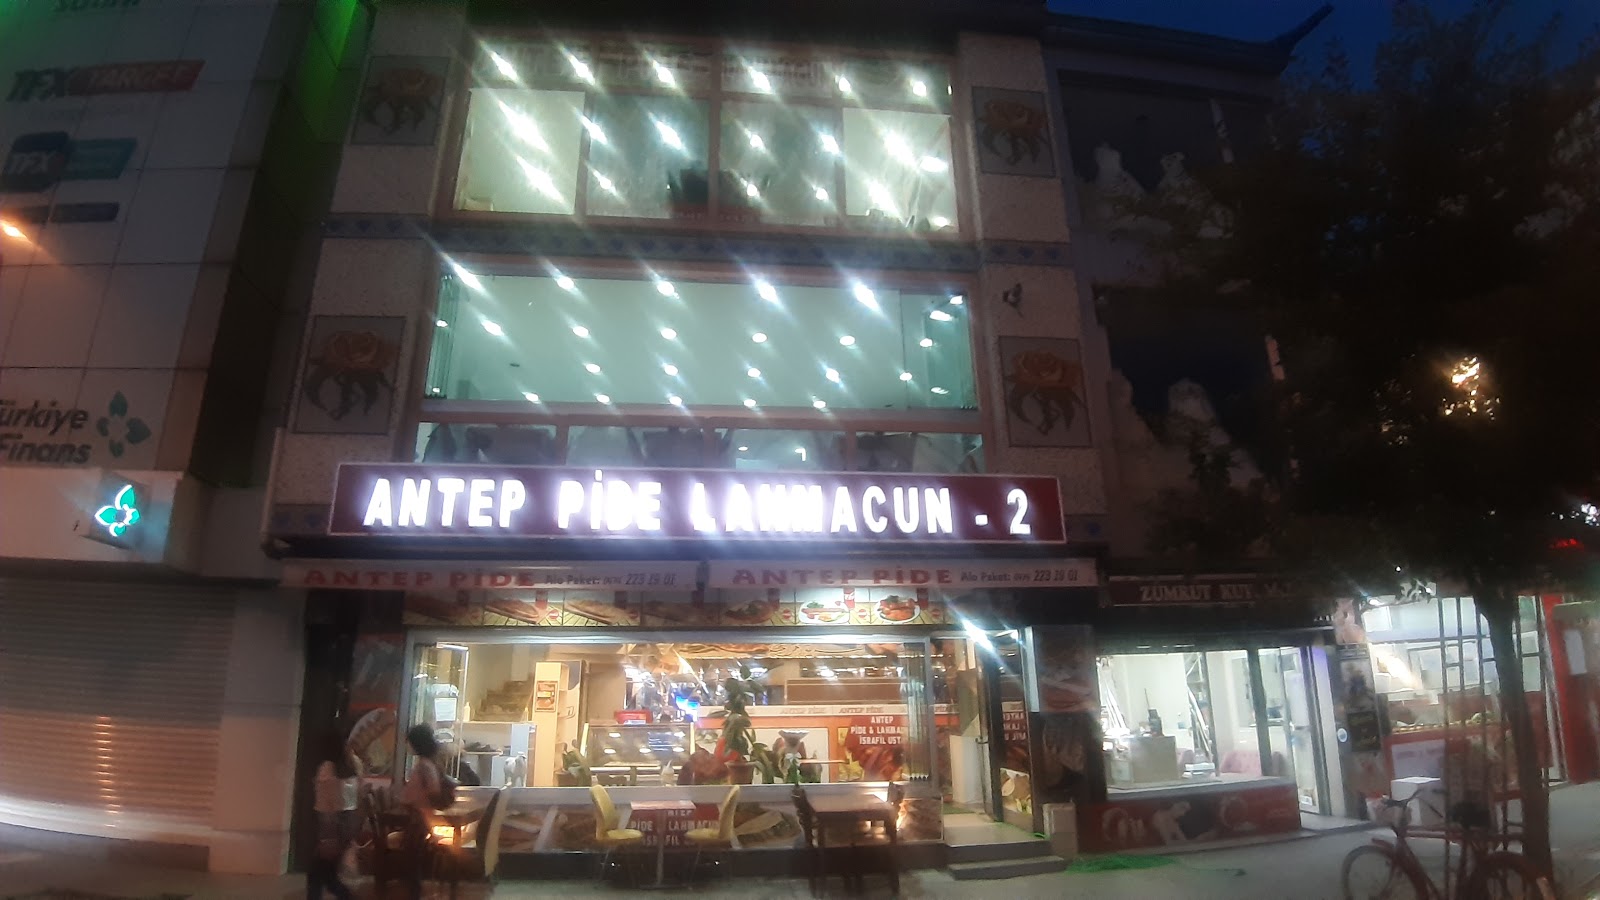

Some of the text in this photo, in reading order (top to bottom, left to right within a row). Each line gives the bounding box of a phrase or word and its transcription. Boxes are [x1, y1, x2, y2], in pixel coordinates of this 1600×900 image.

[0, 400, 89, 436] ürkiye
[363, 477, 527, 528] ANTEP
[557, 469, 662, 531] PİDE
[690, 482, 952, 534] LAHMACUN
[1007, 488, 1031, 535] 2
[303, 570, 433, 586] ANTEP
[732, 569, 859, 585] ANTEP
[873, 566, 952, 585] PİDE
[980, 571, 1011, 582] Paket:
[1033, 569, 1052, 582] 223
[870, 716, 894, 724] ANTEP
[850, 725, 867, 735] PİDE
[869, 726, 875, 734] &
[887, 736, 903, 745] UST
